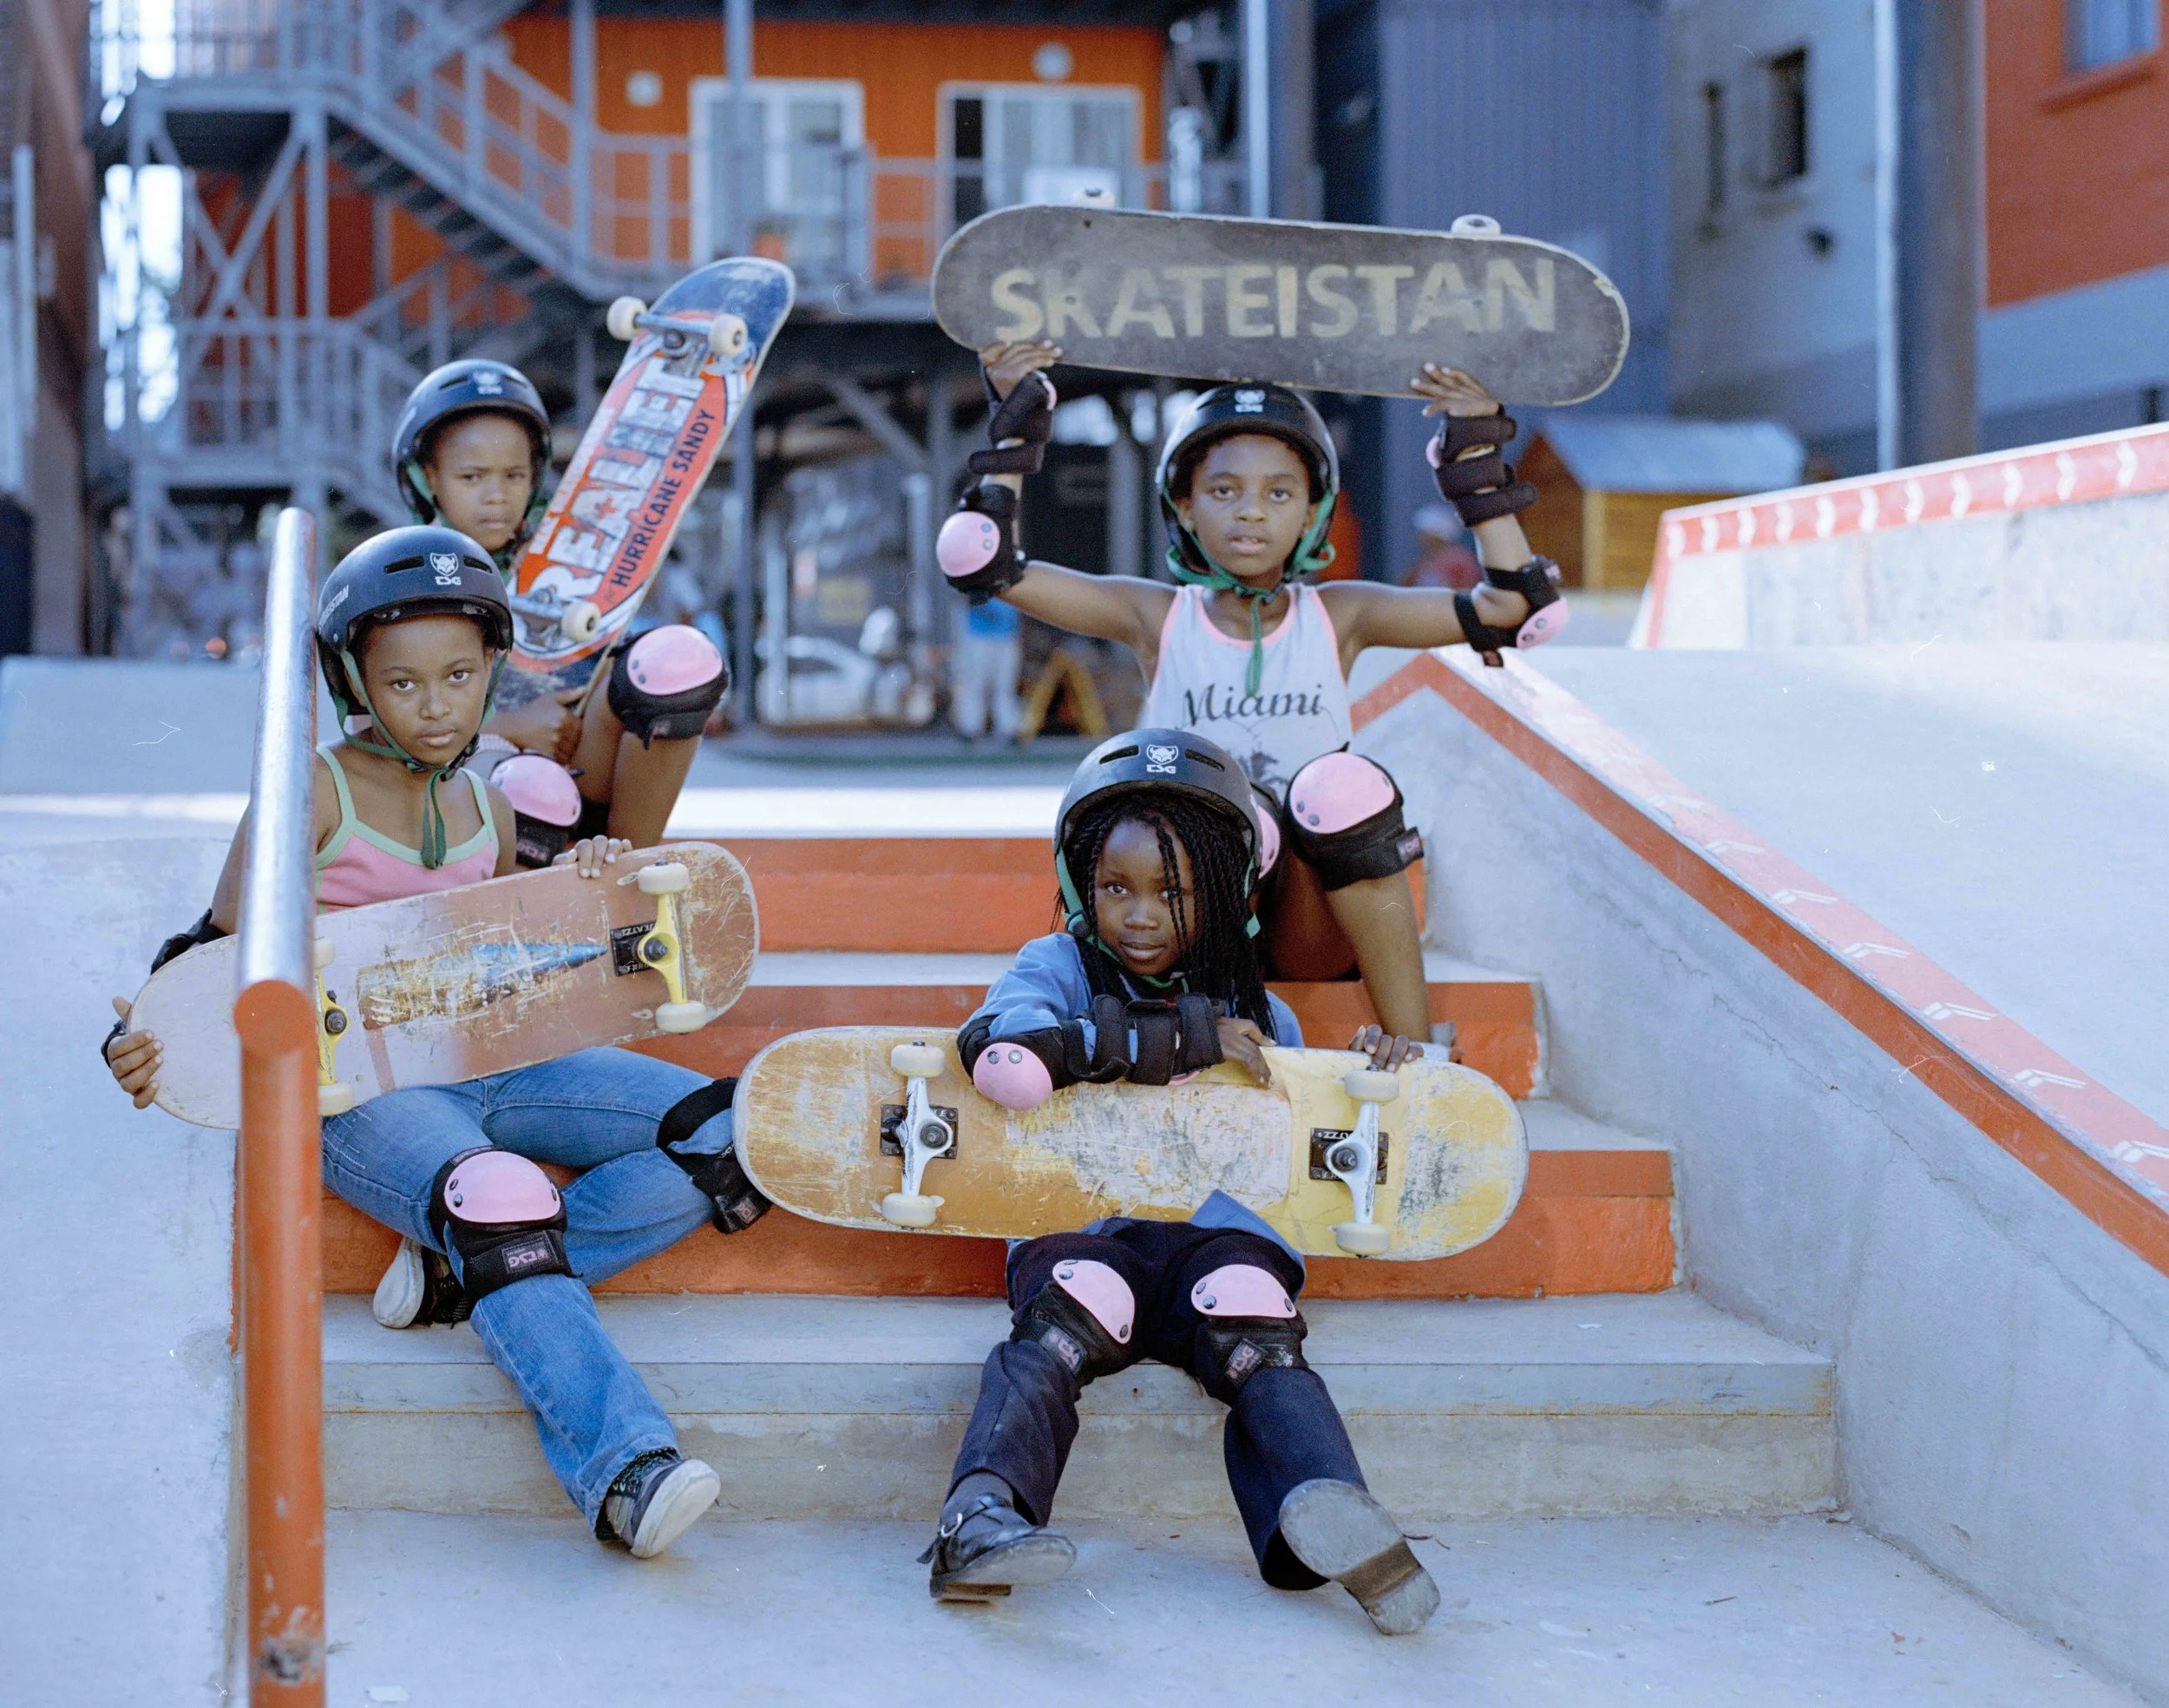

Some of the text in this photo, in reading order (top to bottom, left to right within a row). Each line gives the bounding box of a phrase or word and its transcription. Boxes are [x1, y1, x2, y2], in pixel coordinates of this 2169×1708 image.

[990, 258, 1556, 344] SKATEISTAN
[610, 474, 682, 588] HURRICANE
[672, 409, 716, 473] SANDY
[1176, 682, 1329, 730] Miami
